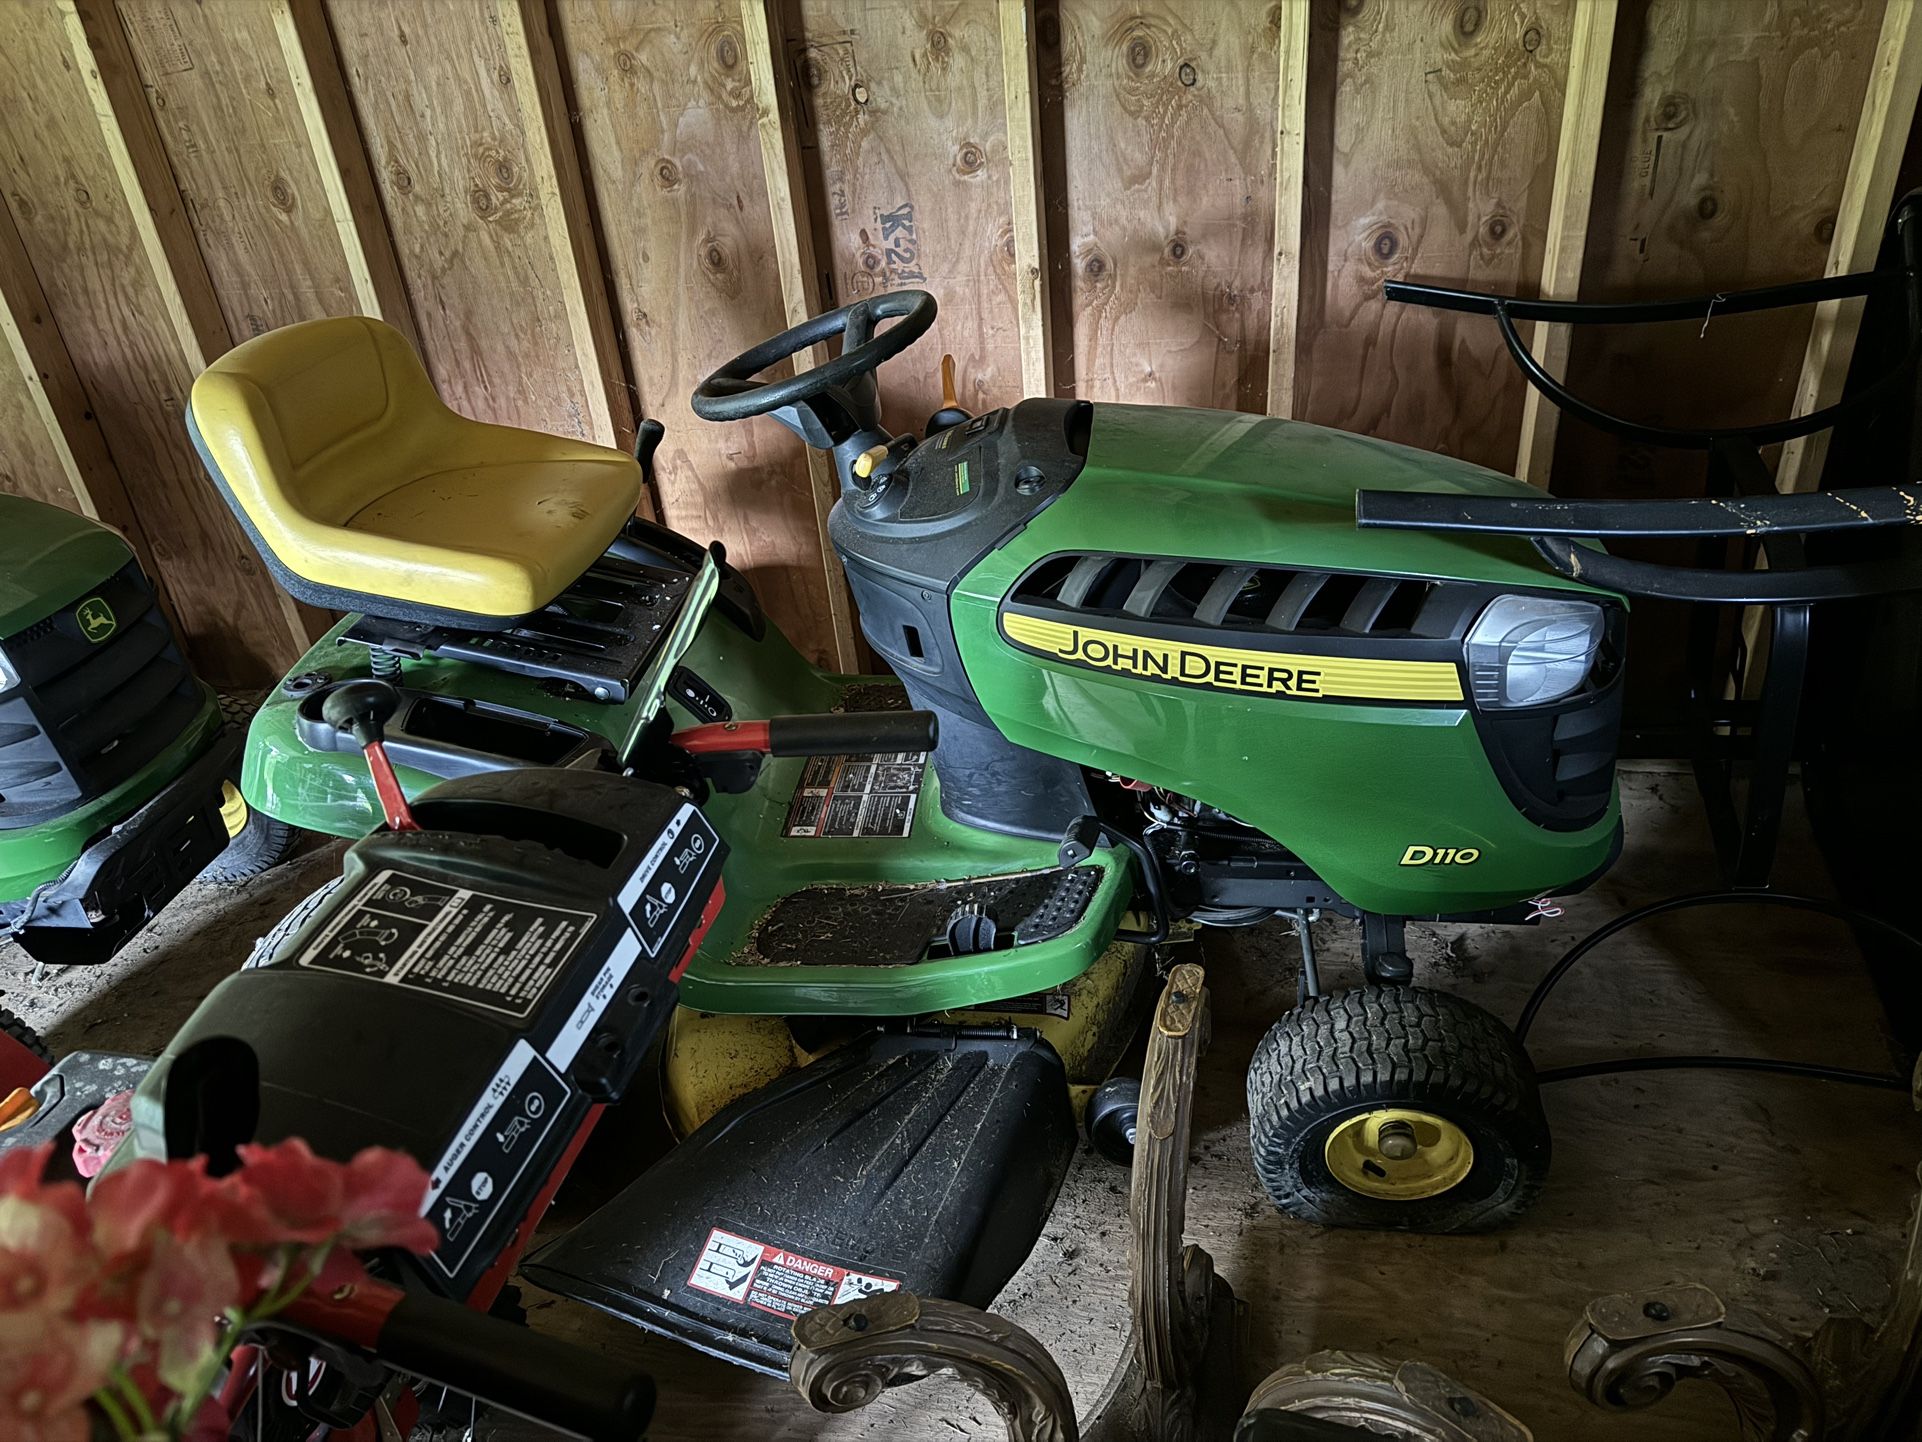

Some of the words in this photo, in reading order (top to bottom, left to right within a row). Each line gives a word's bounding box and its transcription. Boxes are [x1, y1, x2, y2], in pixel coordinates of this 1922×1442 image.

[1058, 630, 1169, 676] JOHN
[1179, 650, 1322, 694] DEERE
[1399, 845, 1480, 866] D110
[442, 1141, 466, 1175] AUGER
[464, 1101, 495, 1143] CONTROL
[474, 1176, 490, 1197] STOP
[772, 1264, 804, 1278] ROTATING
[785, 1254, 834, 1278] DANGER
[765, 1277, 793, 1289] THROWN
